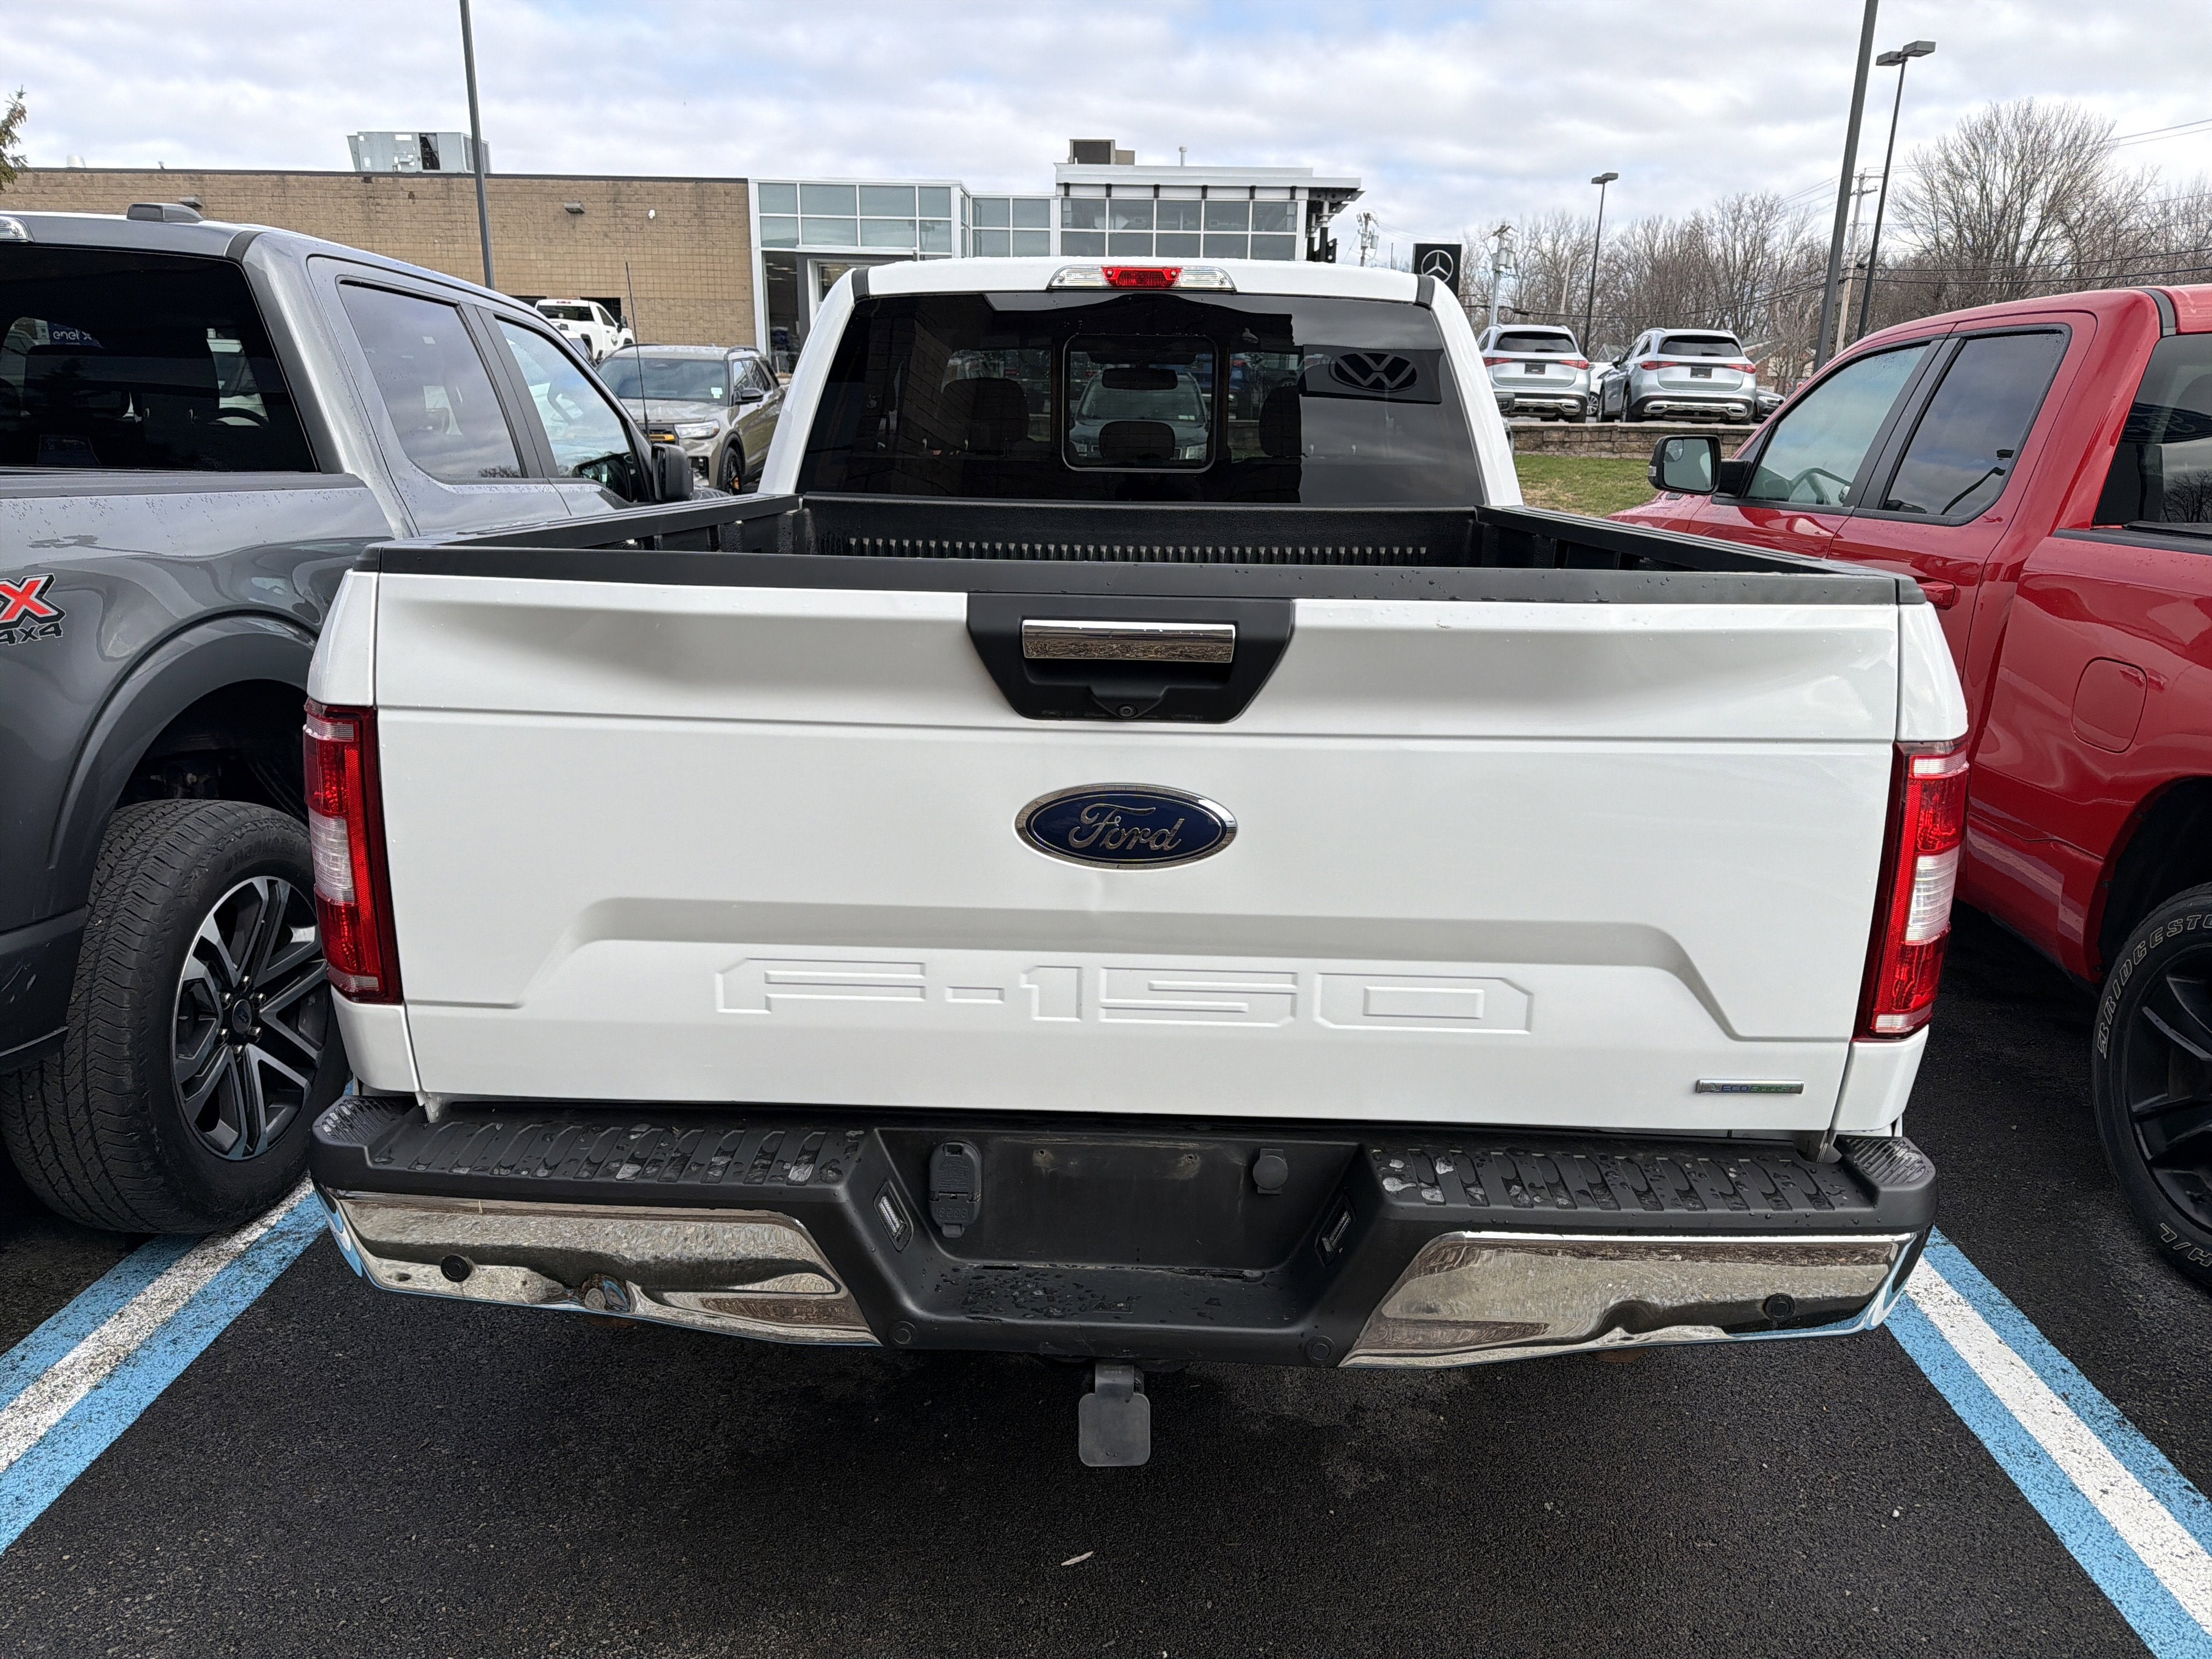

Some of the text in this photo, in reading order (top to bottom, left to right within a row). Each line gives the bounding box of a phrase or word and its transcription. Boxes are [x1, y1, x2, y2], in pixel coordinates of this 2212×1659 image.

[53, 329, 80, 340] enel
[1068, 803, 1186, 852] Ford
[714, 957, 1533, 1035] F-150
